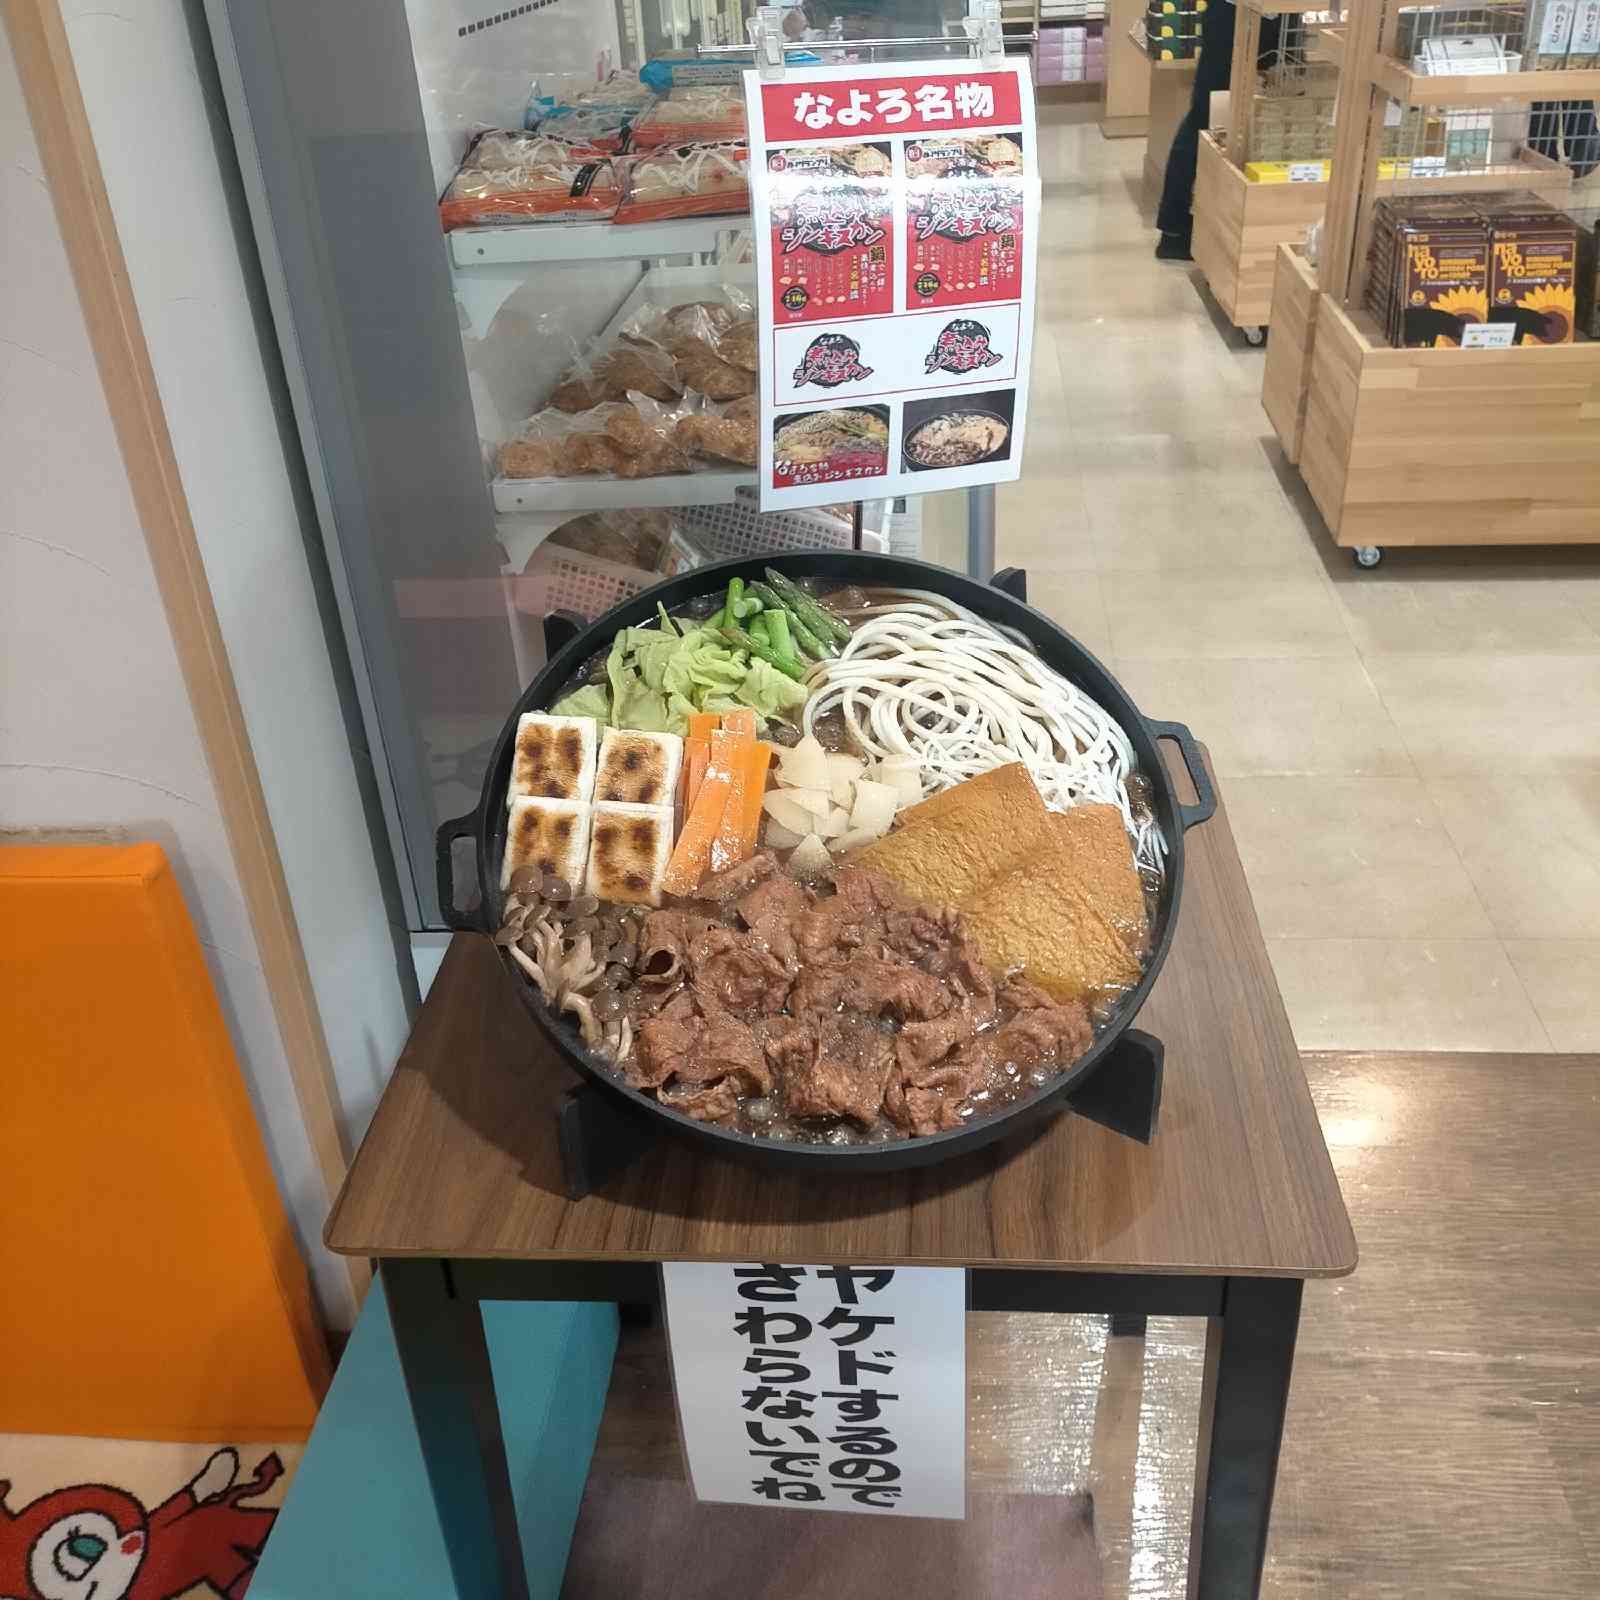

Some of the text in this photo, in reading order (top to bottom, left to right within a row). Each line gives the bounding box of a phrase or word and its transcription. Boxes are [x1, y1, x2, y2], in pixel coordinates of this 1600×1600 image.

[793, 82, 995, 130] なよろ名物
[732, 1263, 826, 1502] さわらないでね
[816, 1265, 903, 1508] ヤケドするので
